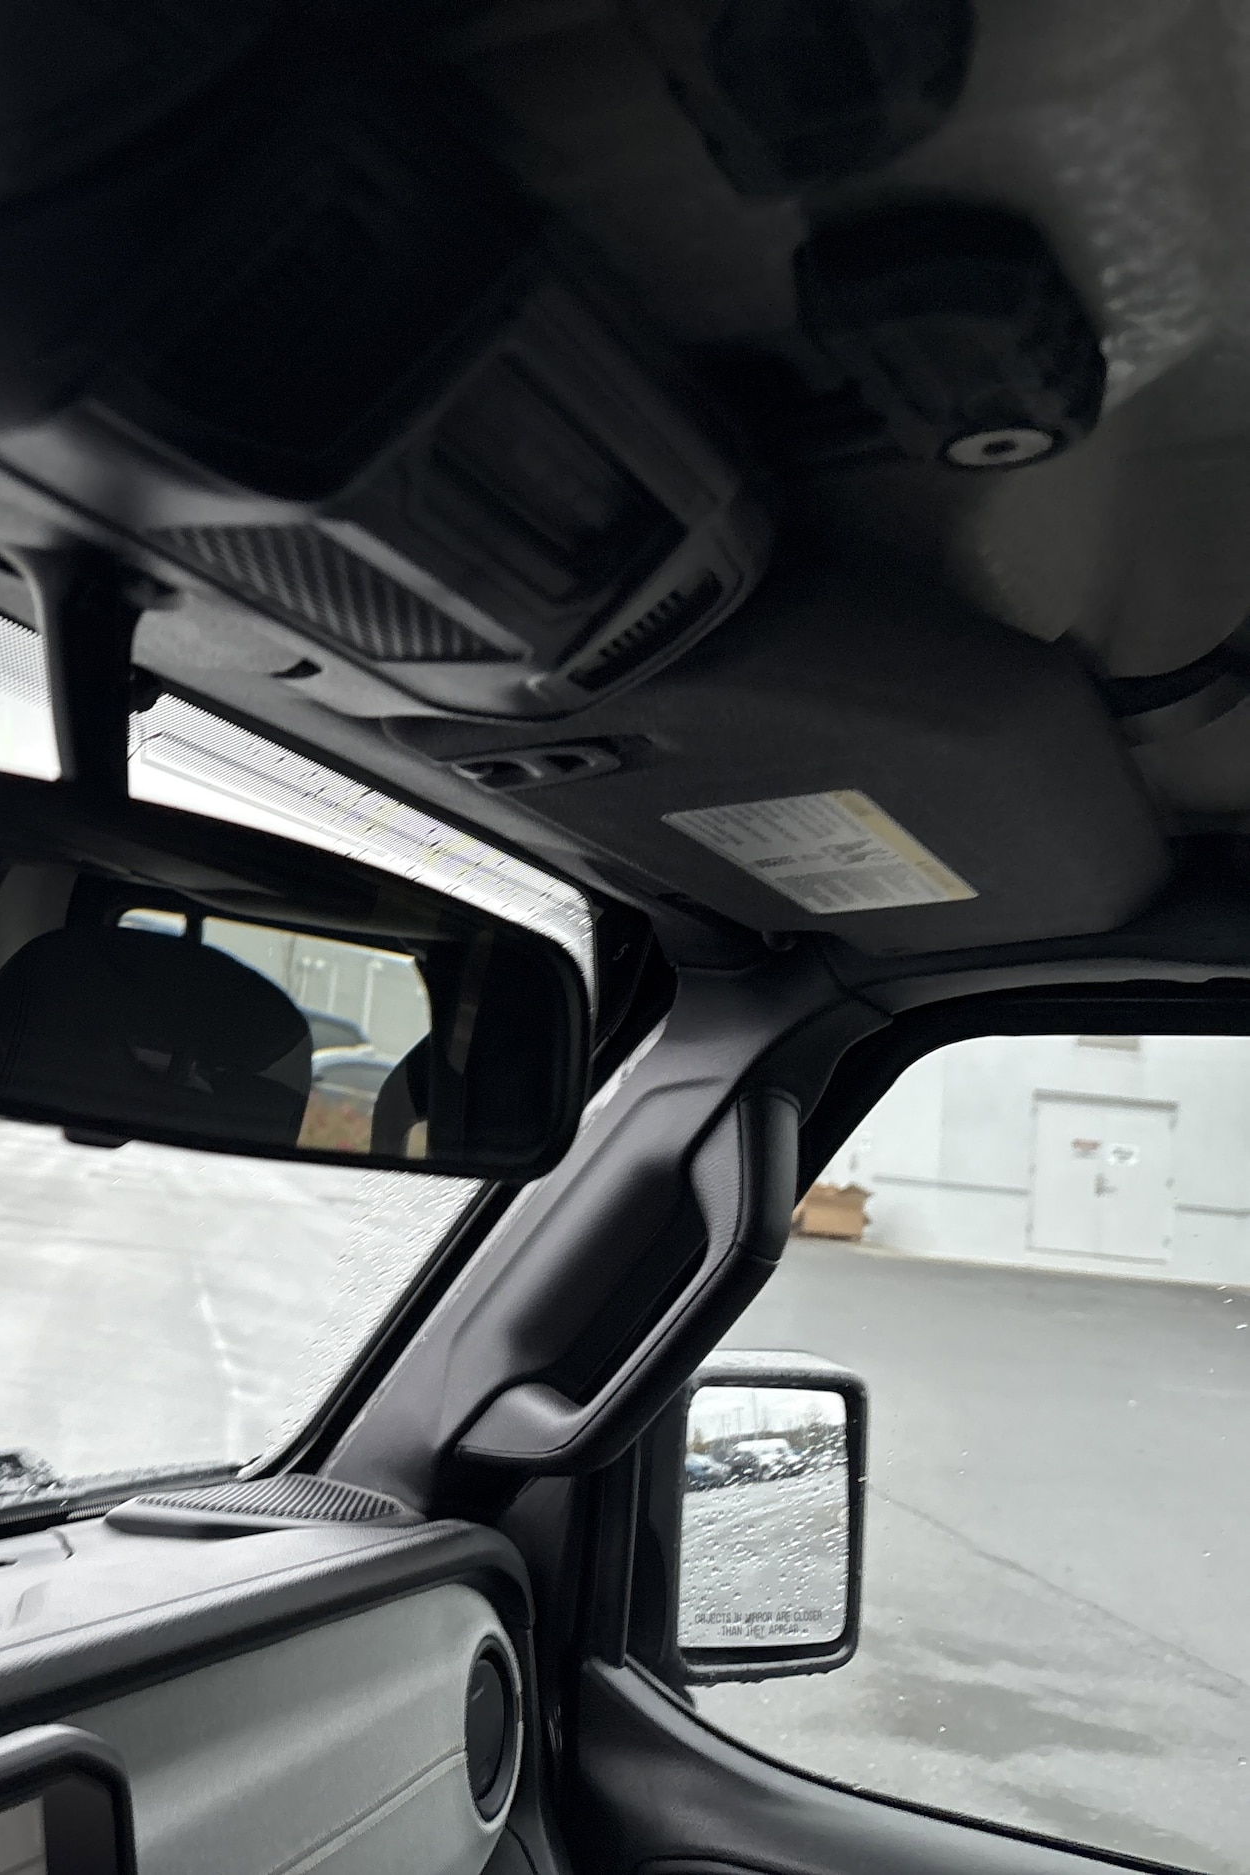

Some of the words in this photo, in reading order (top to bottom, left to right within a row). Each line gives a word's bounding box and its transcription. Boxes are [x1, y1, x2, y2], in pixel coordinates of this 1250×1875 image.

[694, 1612, 731, 1624] OBJECTS
[734, 1612, 742, 1623] IN
[745, 1611, 773, 1623] MIRROR
[776, 1611, 791, 1621] ARE
[794, 1610, 823, 1621] CLOSER
[721, 1626, 742, 1636] THAN
[746, 1624, 765, 1636] THEY
[768, 1624, 800, 1635] APPEAR
